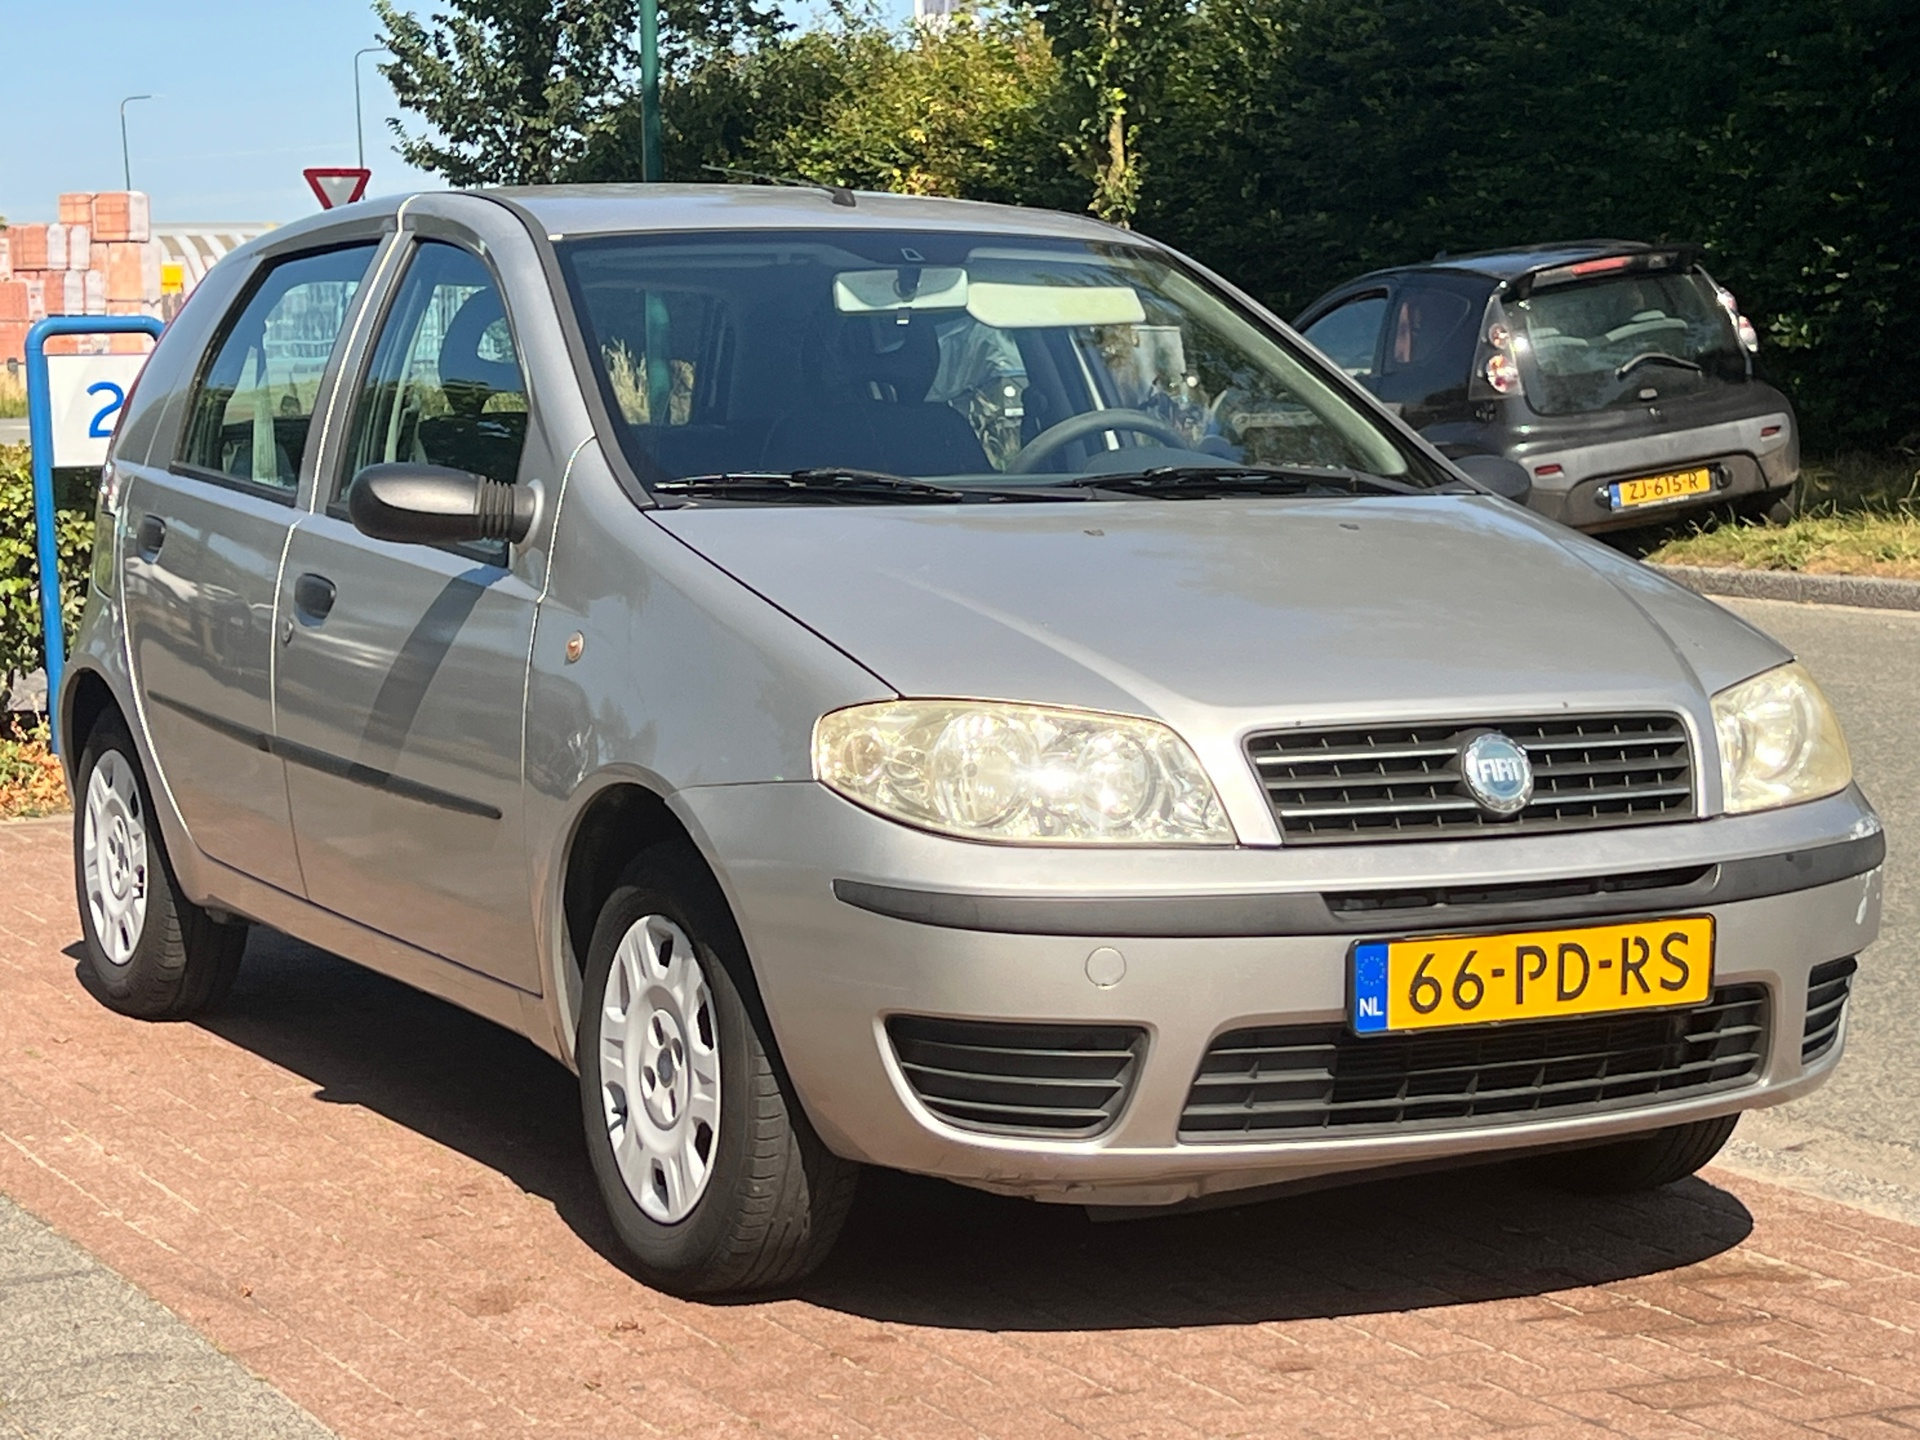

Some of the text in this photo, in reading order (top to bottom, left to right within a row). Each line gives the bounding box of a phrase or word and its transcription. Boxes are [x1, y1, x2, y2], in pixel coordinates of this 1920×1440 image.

[86, 381, 124, 438] 2
[1628, 472, 1699, 501] ZJ-615-R
[1478, 757, 1521, 783] FIAT
[1359, 931, 1690, 1017] NL 66-PD-RS
